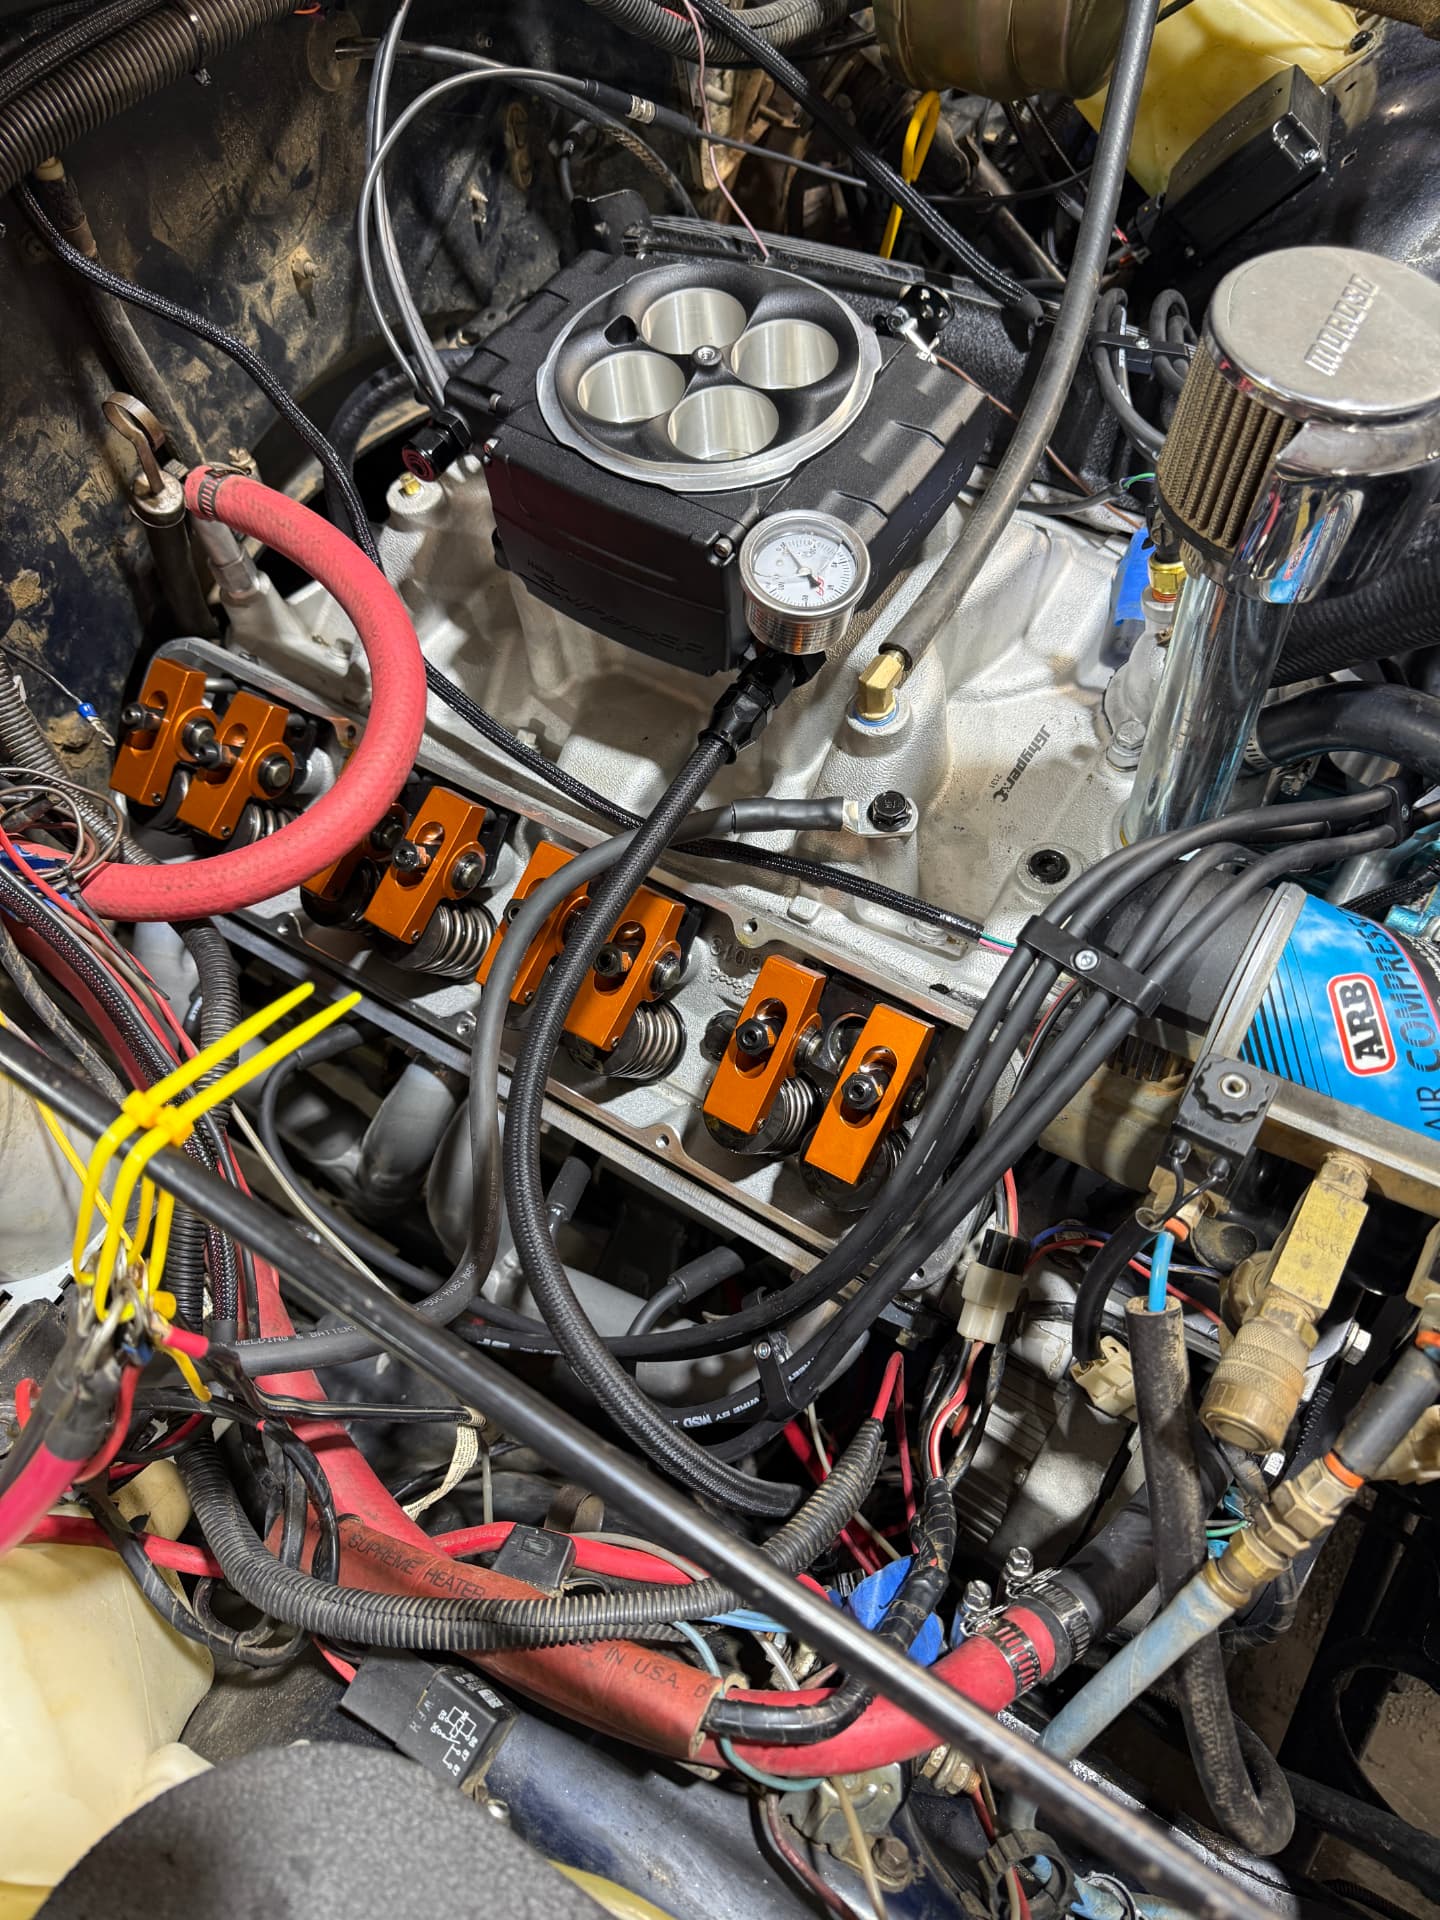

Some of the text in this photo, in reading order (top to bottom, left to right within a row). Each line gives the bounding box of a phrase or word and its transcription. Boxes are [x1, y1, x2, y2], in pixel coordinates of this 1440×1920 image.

[1337, 907, 1440, 1073] COMPRESS
[1340, 981, 1387, 1061] ARB
[234, 1335, 289, 1347] WELDING
[682, 1412, 713, 1428] MSD
[347, 1533, 418, 1576] SUPREME
[422, 1567, 486, 1600] HEATER
[604, 1645, 626, 1665] IN
